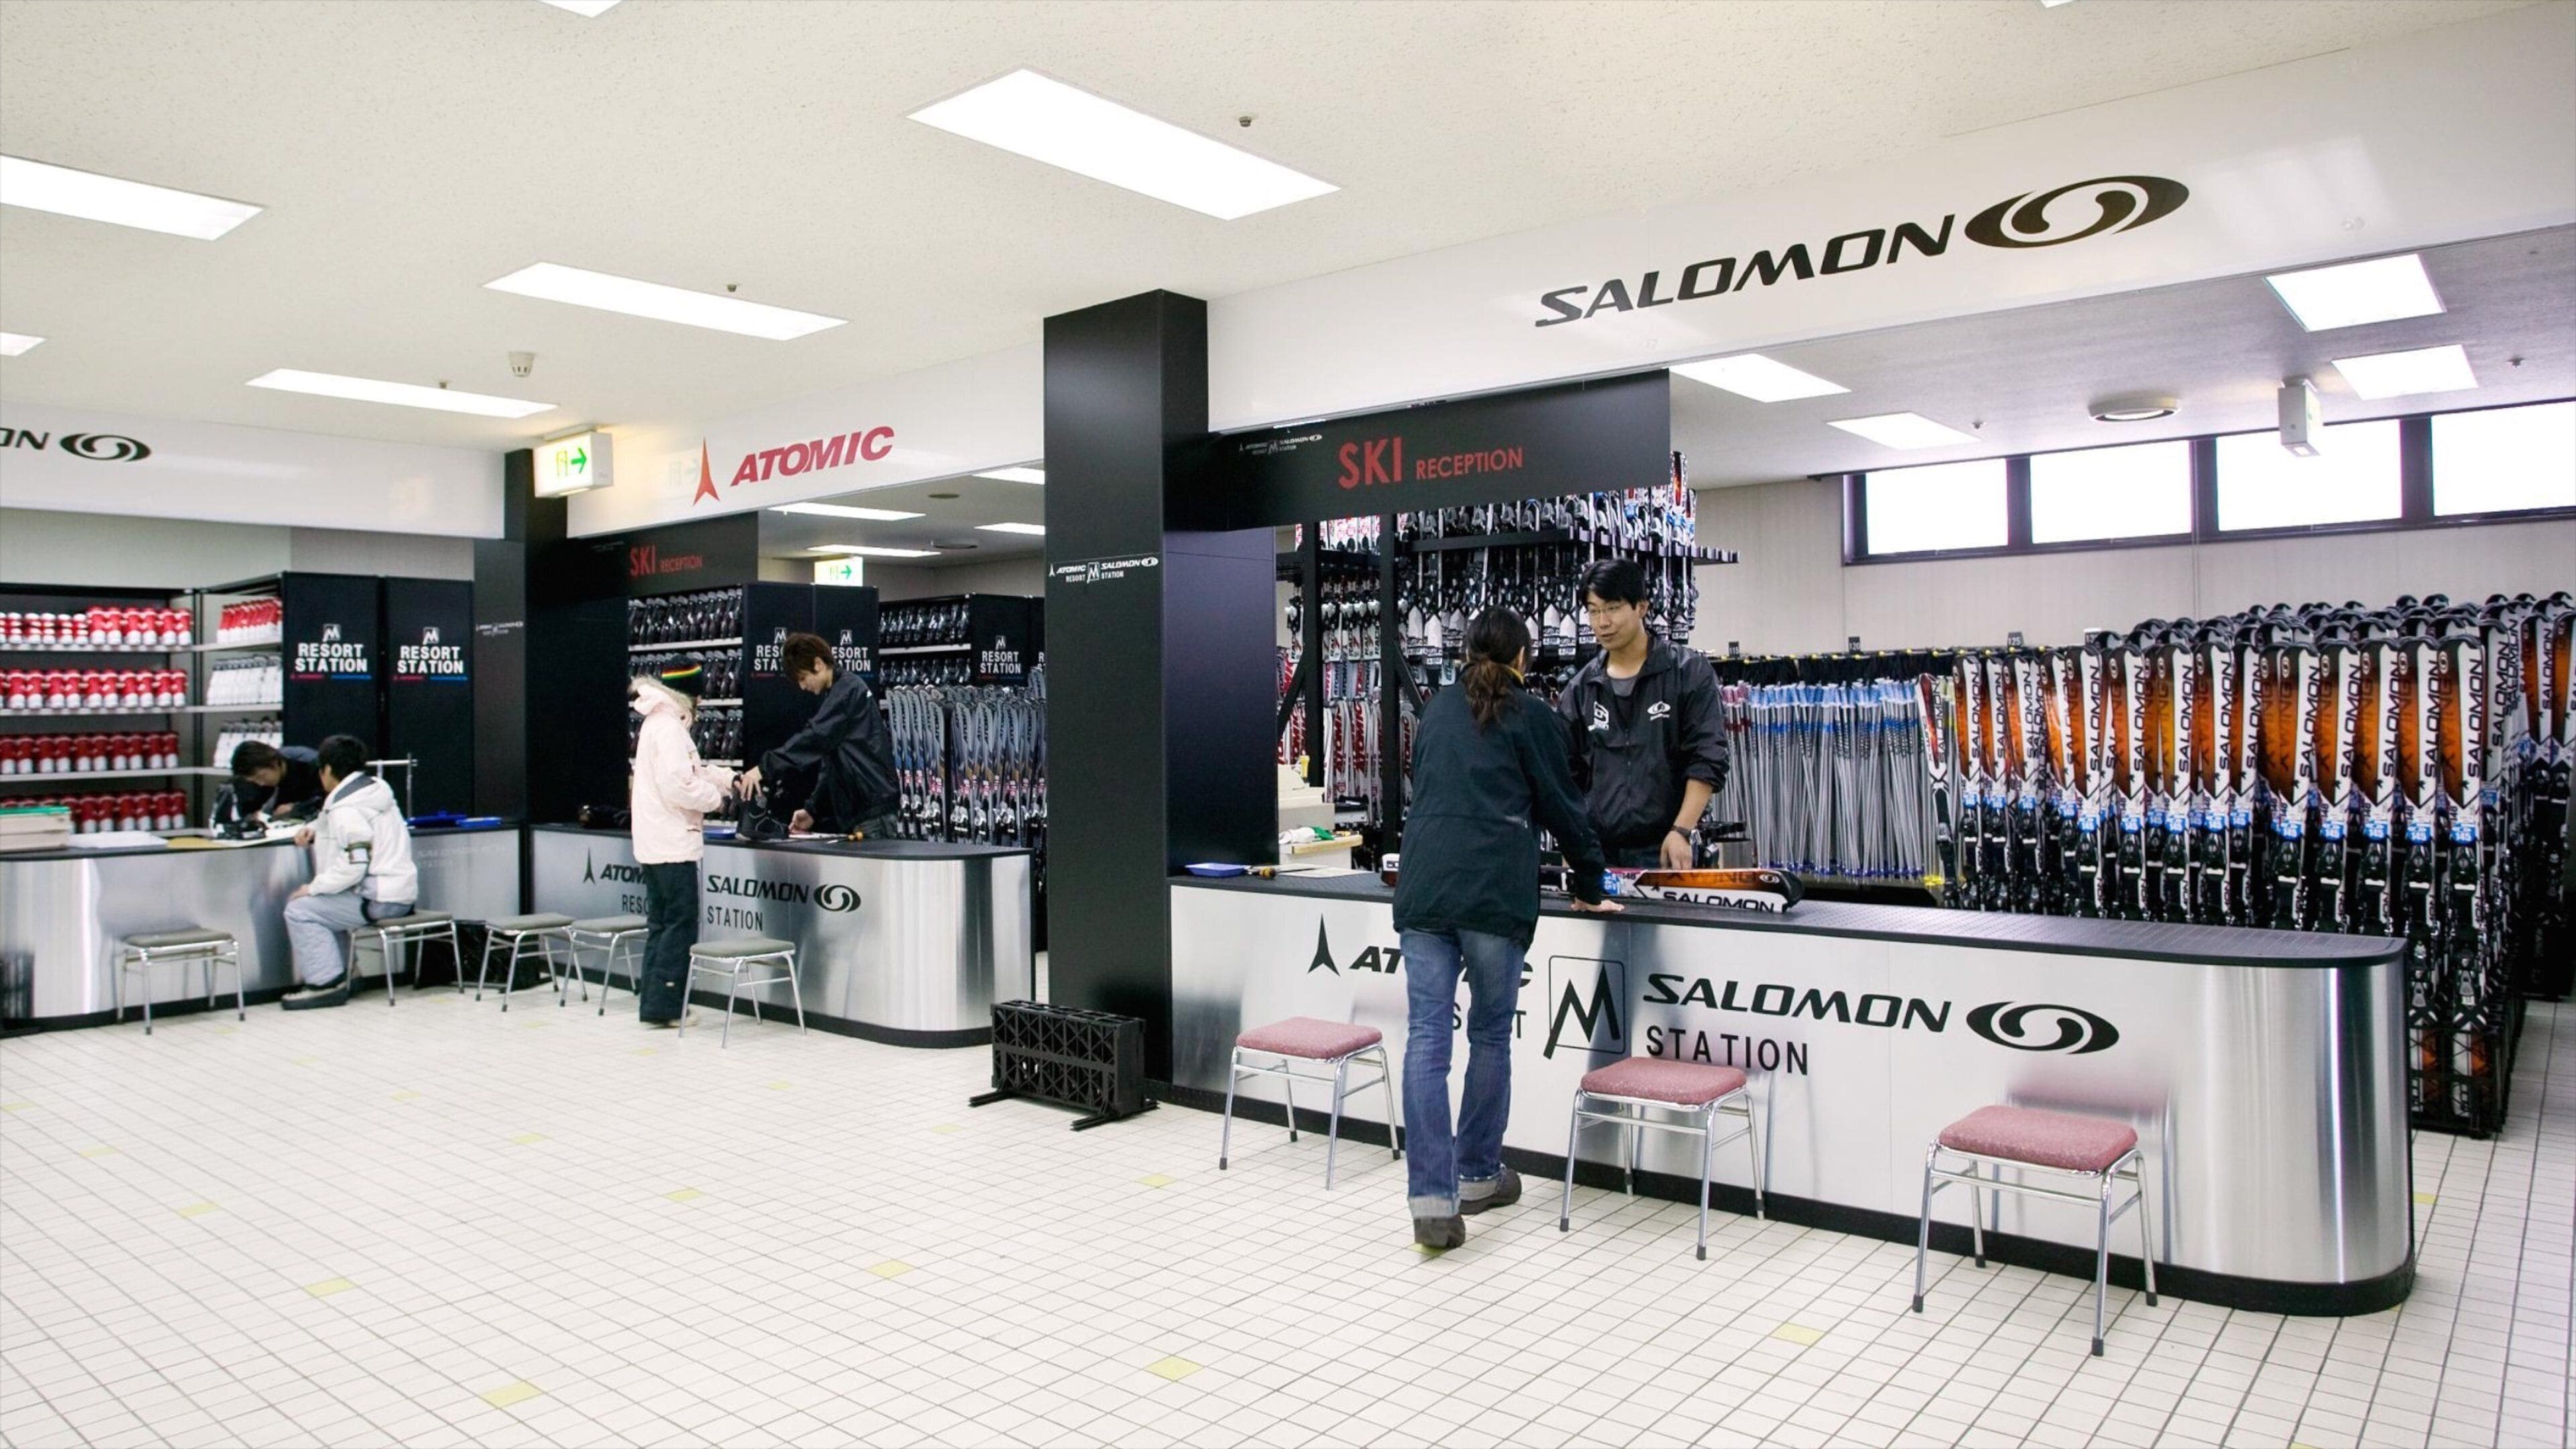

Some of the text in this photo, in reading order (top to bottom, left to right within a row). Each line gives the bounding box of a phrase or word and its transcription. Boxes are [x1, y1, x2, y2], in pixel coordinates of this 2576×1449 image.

[1535, 213, 1955, 327] SALOMON
[730, 426, 894, 486] ATOMIC
[1338, 437, 1522, 489] SKI RECEPTION
[630, 545, 656, 576] SKI
[659, 555, 702, 573] RECEPTION
[1057, 564, 1086, 574] ATOMIC
[1101, 559, 1140, 570] SALOMON
[1065, 570, 1124, 582] RESORT STATION
[298, 643, 364, 657] RESORT
[400, 646, 461, 659] RESORT
[756, 645, 784, 658] RES
[832, 647, 869, 659] ESORT
[981, 651, 1019, 662] RESORT
[1849, 641, 1860, 651] 120
[2008, 637, 2021, 646] 125
[2086, 634, 2098, 644] 13
[295, 658, 368, 672] STATION
[397, 660, 464, 674] STATION
[980, 663, 1021, 674] STATION
[2542, 629, 2552, 710] SALOMON
[1972, 672, 1980, 758] SALOMON
[1994, 672, 2006, 758] SALOMON
[2023, 671, 2035, 759] SALOMON
[2219, 661, 2232, 770] SALOMON
[2492, 641, 2510, 746] SALOMON
[1933, 680, 1946, 763] SALOMON
[2090, 665, 2101, 771] SALOMON
[2134, 665, 2145, 772] SALOMON
[2180, 665, 2192, 772] SALOMON
[2247, 663, 2261, 769] SALOMON
[2300, 665, 2320, 777] SALOMON
[2341, 664, 2361, 777] SALOMON
[2383, 661, 2400, 777] SALOMON
[2424, 660, 2440, 778] SALOMON
[2468, 659, 2482, 777] SALOMON
[1353, 701, 1366, 777] ATOMIC
[1401, 714, 1411, 777] ATOMIC
[2320, 803, 2329, 818] 148
[2363, 803, 2371, 818] 148
[2406, 805, 2414, 820] 148
[2449, 806, 2458, 821] 148
[2411, 830, 2427, 841] 145
[2456, 830, 2472, 841] 145
[601, 864, 808, 903] ATOM SALOMON
[1664, 891, 1774, 913] SALOMON
[622, 894, 763, 932] RESO STATION
[1644, 973, 1951, 1033] SALOMON
[1646, 1025, 1809, 1075] STATION
